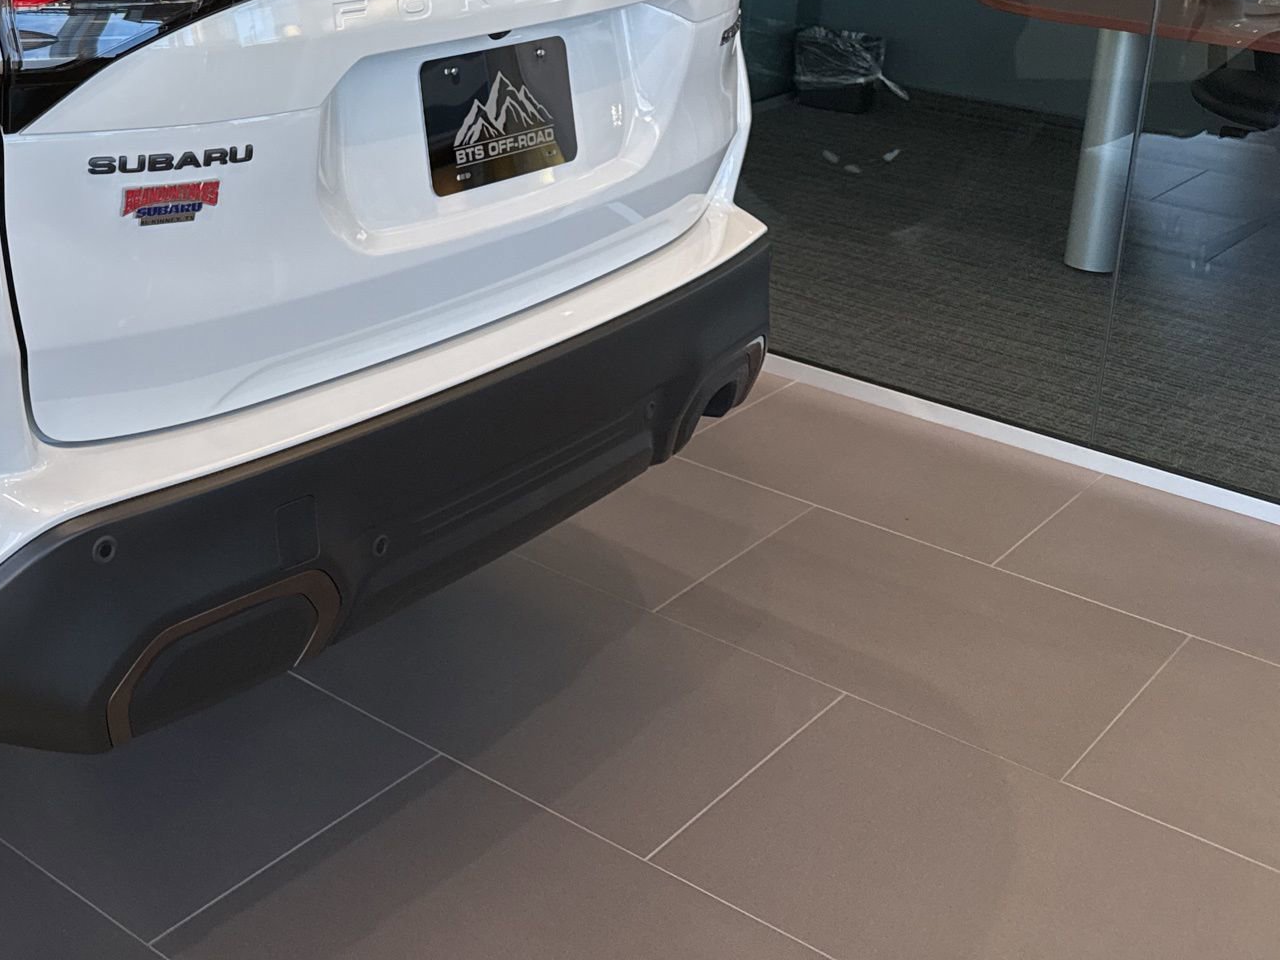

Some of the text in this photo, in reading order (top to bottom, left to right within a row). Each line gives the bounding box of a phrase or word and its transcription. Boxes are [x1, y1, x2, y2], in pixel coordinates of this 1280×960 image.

[87, 144, 254, 175] SUBARU
[455, 128, 555, 164] BTS OFF-ROAD
[136, 202, 203, 219] SUBARU
